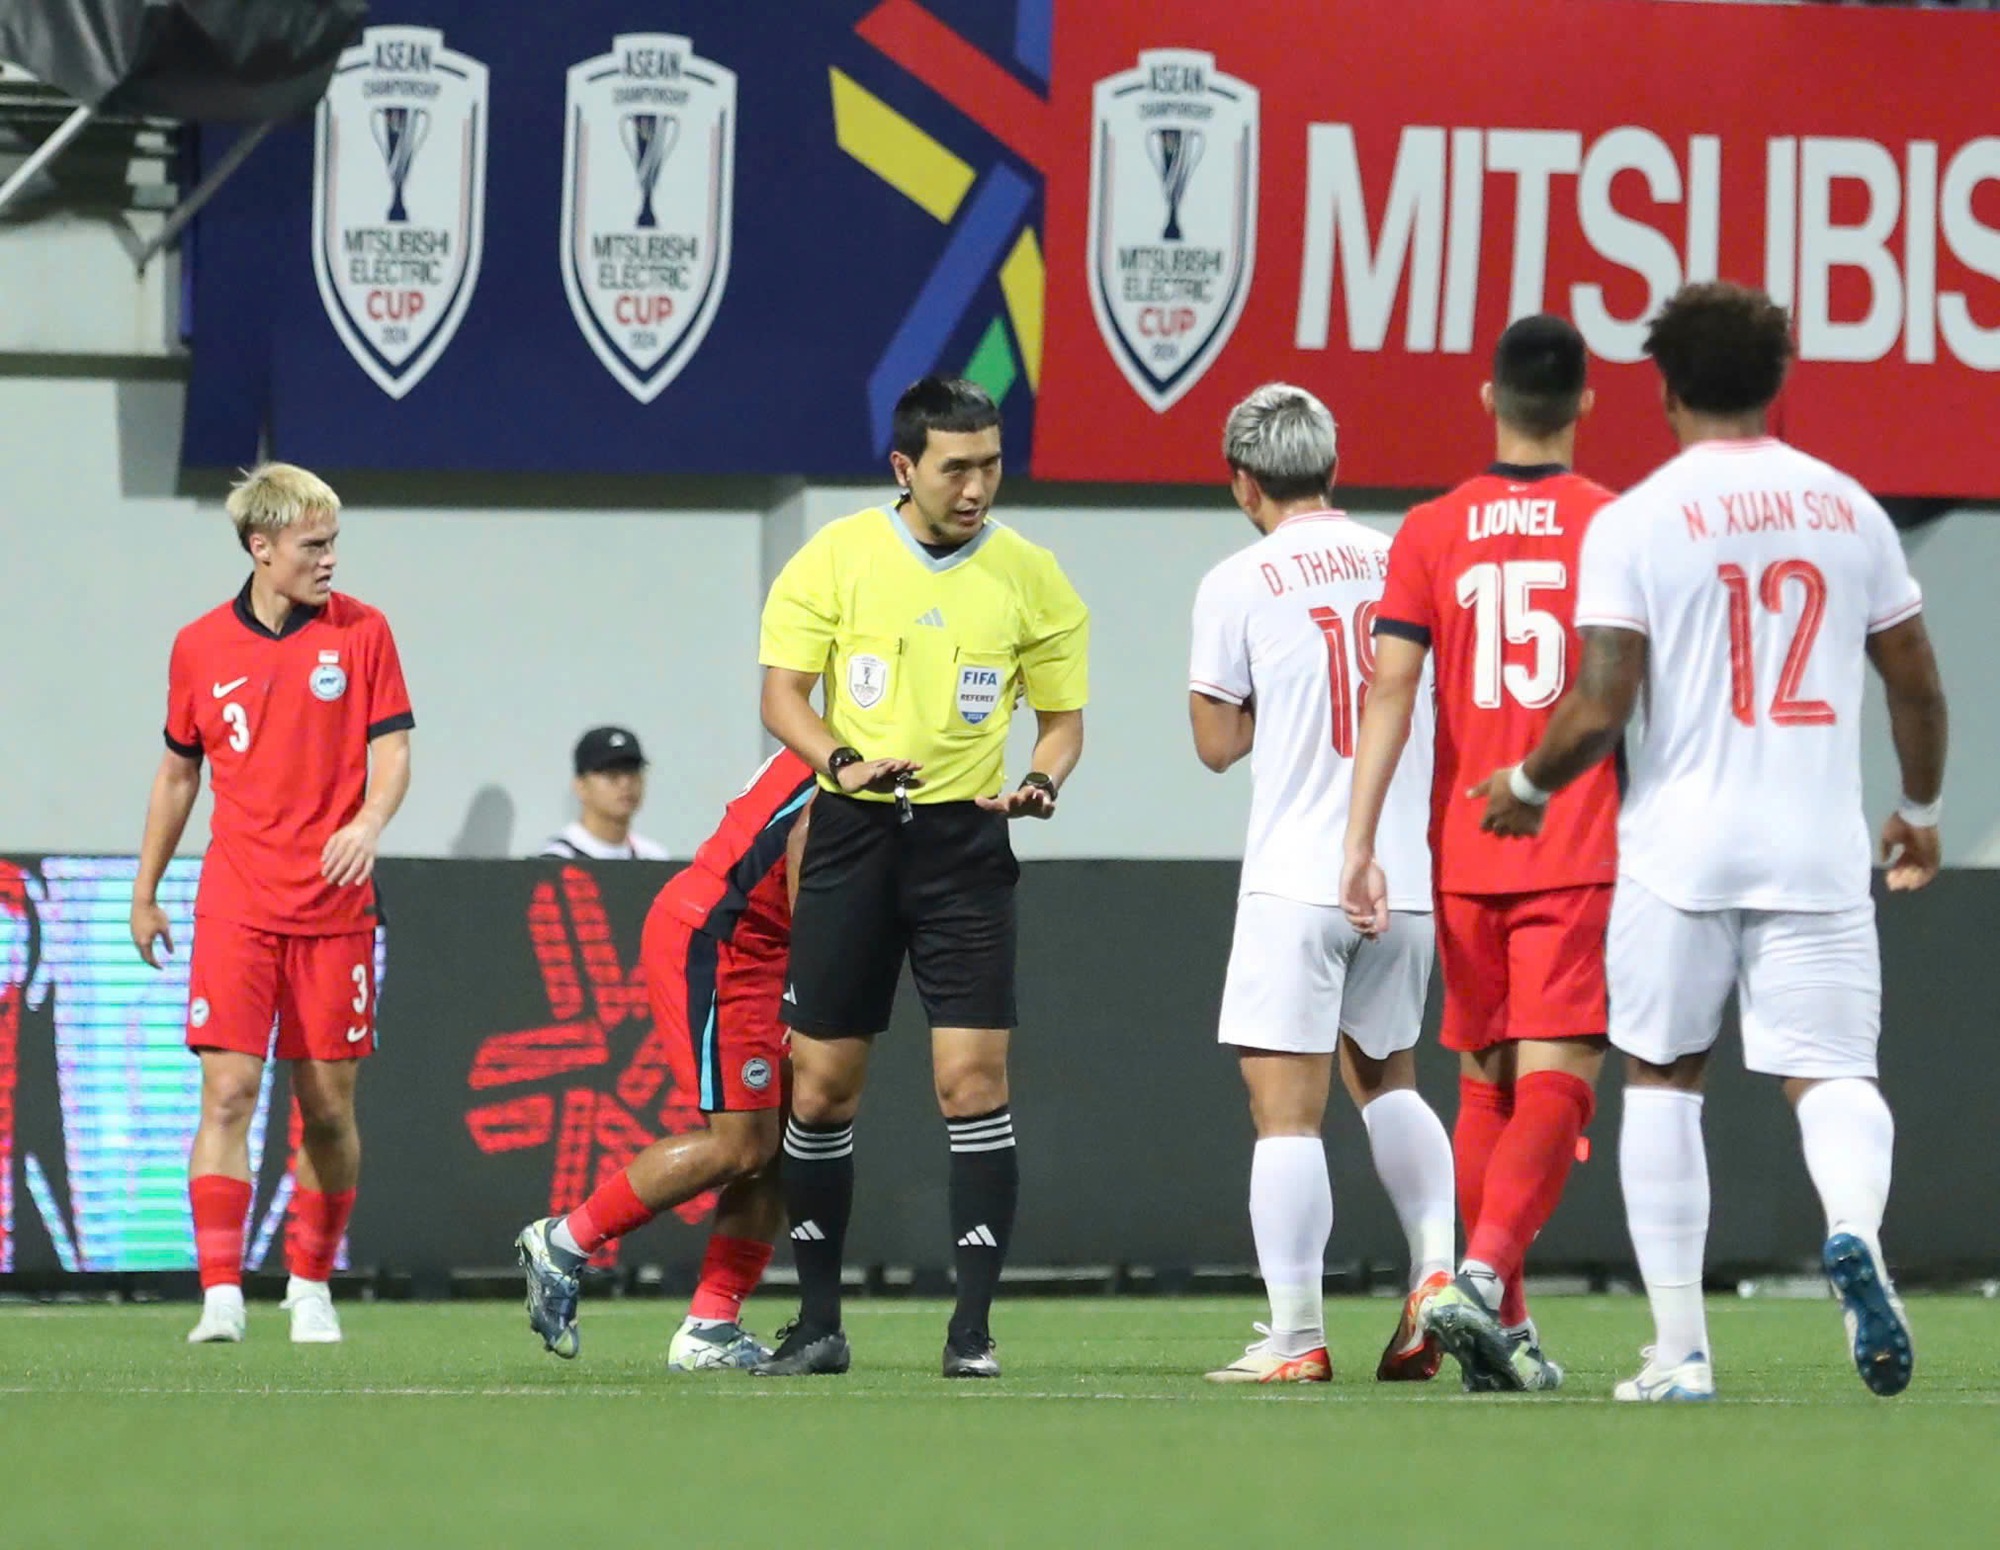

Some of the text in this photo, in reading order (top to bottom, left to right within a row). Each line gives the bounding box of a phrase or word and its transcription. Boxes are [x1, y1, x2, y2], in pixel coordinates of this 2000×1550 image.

[375, 41, 430, 71] ASEAN
[625, 49, 681, 79] ASEAN
[1149, 64, 1205, 95] ASEAN
[350, 259, 442, 285] ELECTRIC
[599, 264, 690, 290] ELECTRIC
[367, 290, 425, 320] CUP
[1124, 277, 1213, 303] ELECTRIC
[615, 295, 673, 325] CUP
[1138, 307, 1197, 337] CUP
[1467, 499, 1563, 542] LIONEL
[1682, 490, 1858, 541] N. XUAN SON
[1260, 562, 1294, 597] D.
[1291, 545, 1372, 588] THANH
[1456, 559, 1567, 709] 15
[1717, 559, 1837, 728] 12
[963, 671, 997, 686] FIFA
[961, 694, 995, 703] REFEREE
[222, 702, 250, 753] 3
[351, 963, 369, 1014] 3
